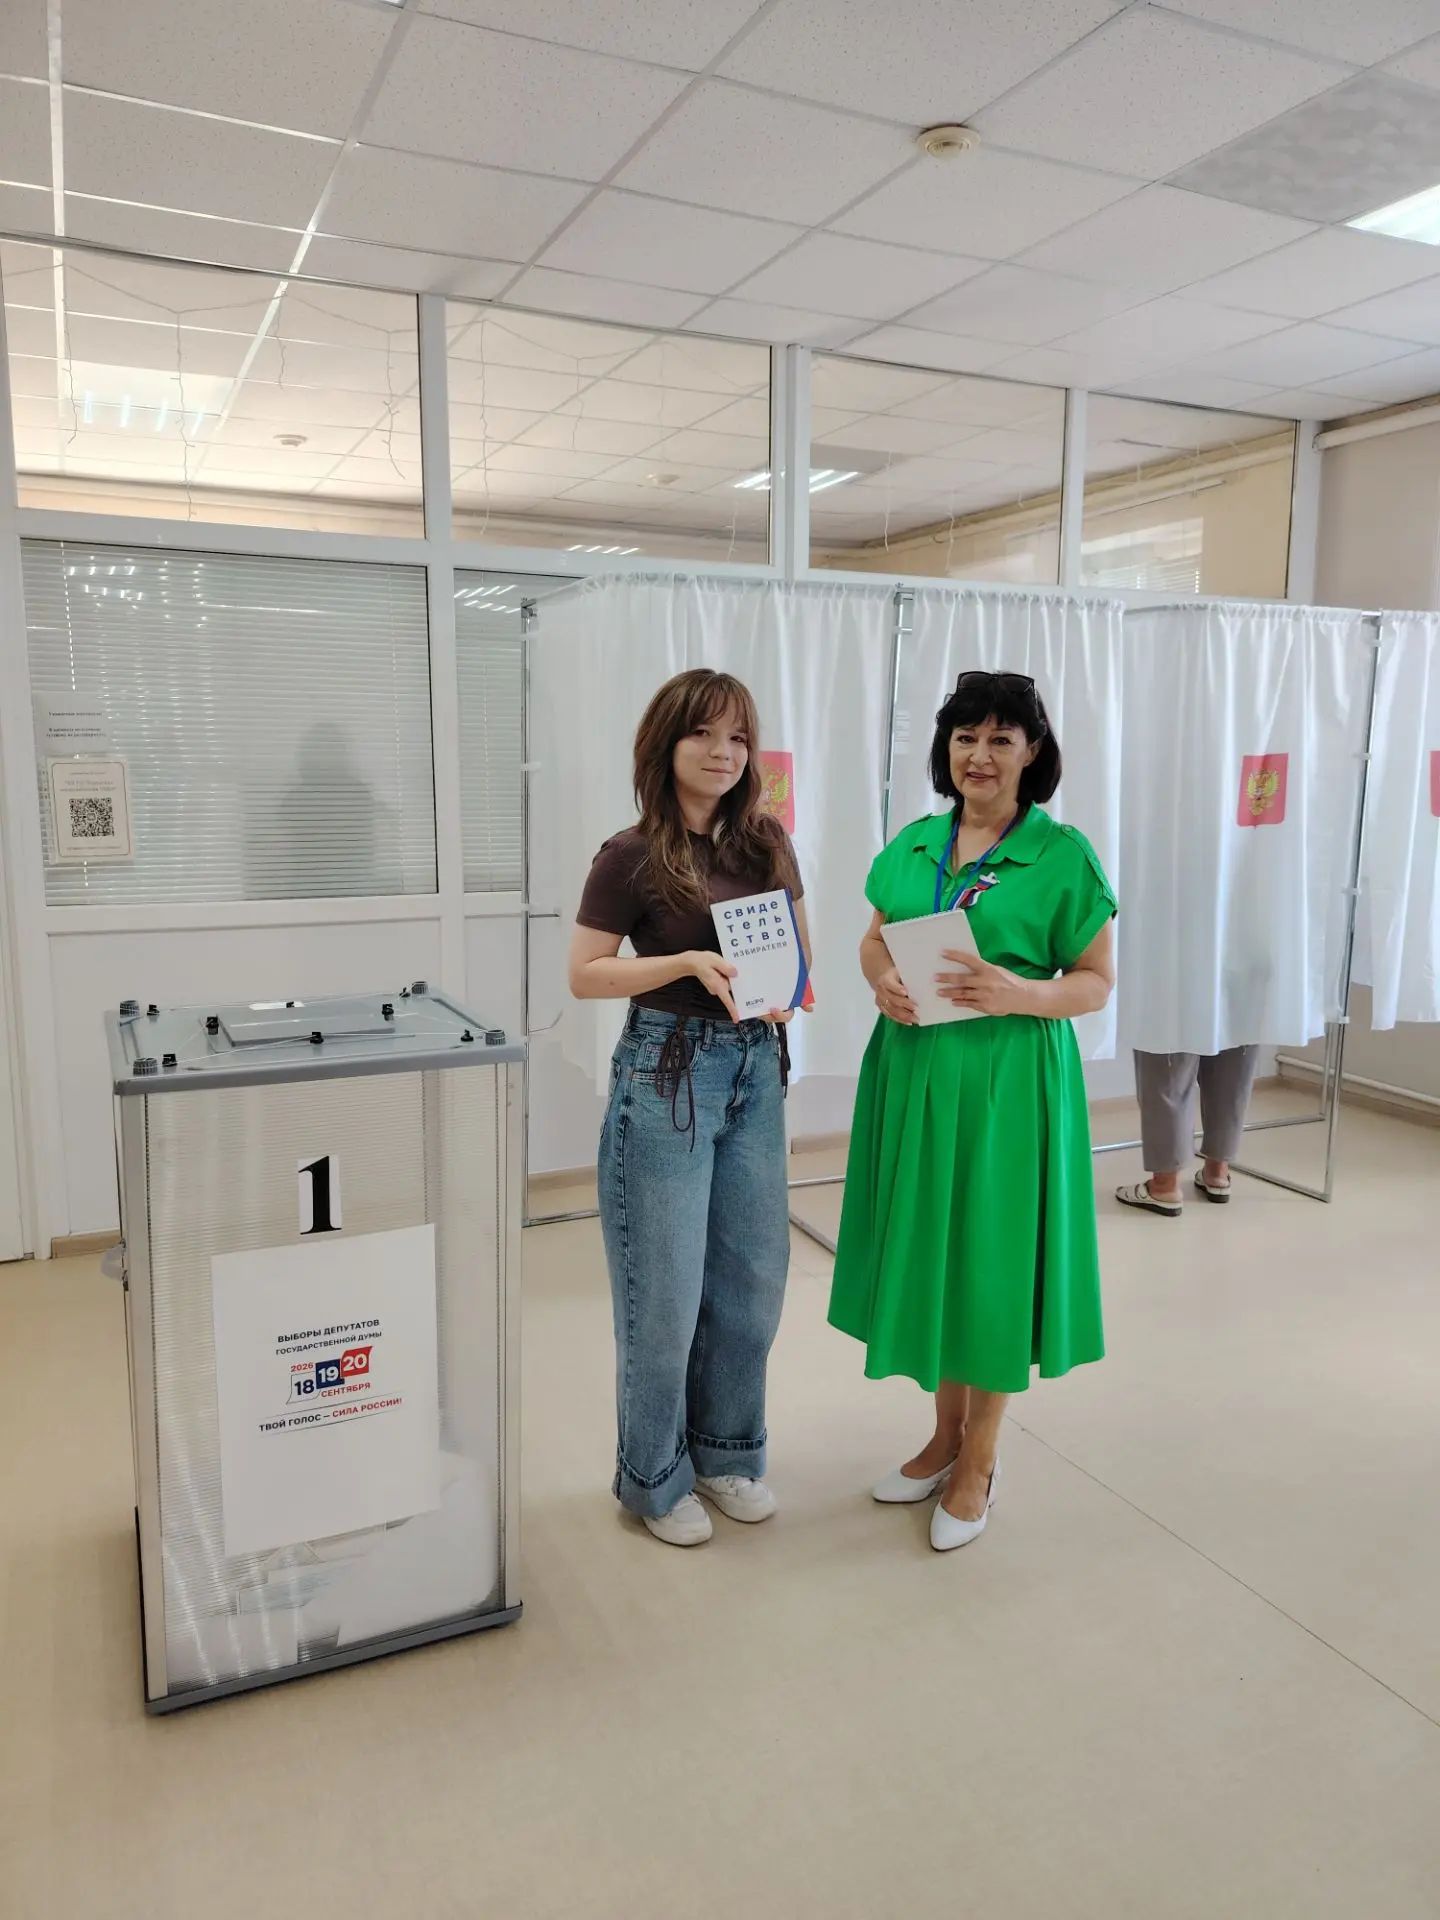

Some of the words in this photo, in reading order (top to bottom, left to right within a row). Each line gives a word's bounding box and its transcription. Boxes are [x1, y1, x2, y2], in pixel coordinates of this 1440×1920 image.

[724, 901, 778, 919] свиде
[727, 916, 782, 933] тель
[730, 928, 785, 947] ство
[733, 941, 788, 958] ИЗБИРАТЕЛЯ
[298, 1155, 342, 1236] 1
[277, 1329, 322, 1343] ВЫБОРЫ
[323, 1319, 379, 1335] ДЕПУТАТОВ
[275, 1335, 356, 1355] ГОСУДАРСТВЕННОЙ
[357, 1331, 382, 1342] ДУМЫ
[290, 1362, 314, 1373] 2026
[294, 1379, 315, 1396] 18
[318, 1366, 340, 1384] 19
[342, 1353, 368, 1372] 20
[321, 1382, 371, 1398] СЕНТЯБРЯ
[259, 1419, 287, 1432] ТВОЙ
[288, 1413, 322, 1427] ГОЛОС
[332, 1406, 359, 1419] СИЛА
[360, 1398, 403, 1412] РОССИИ!
